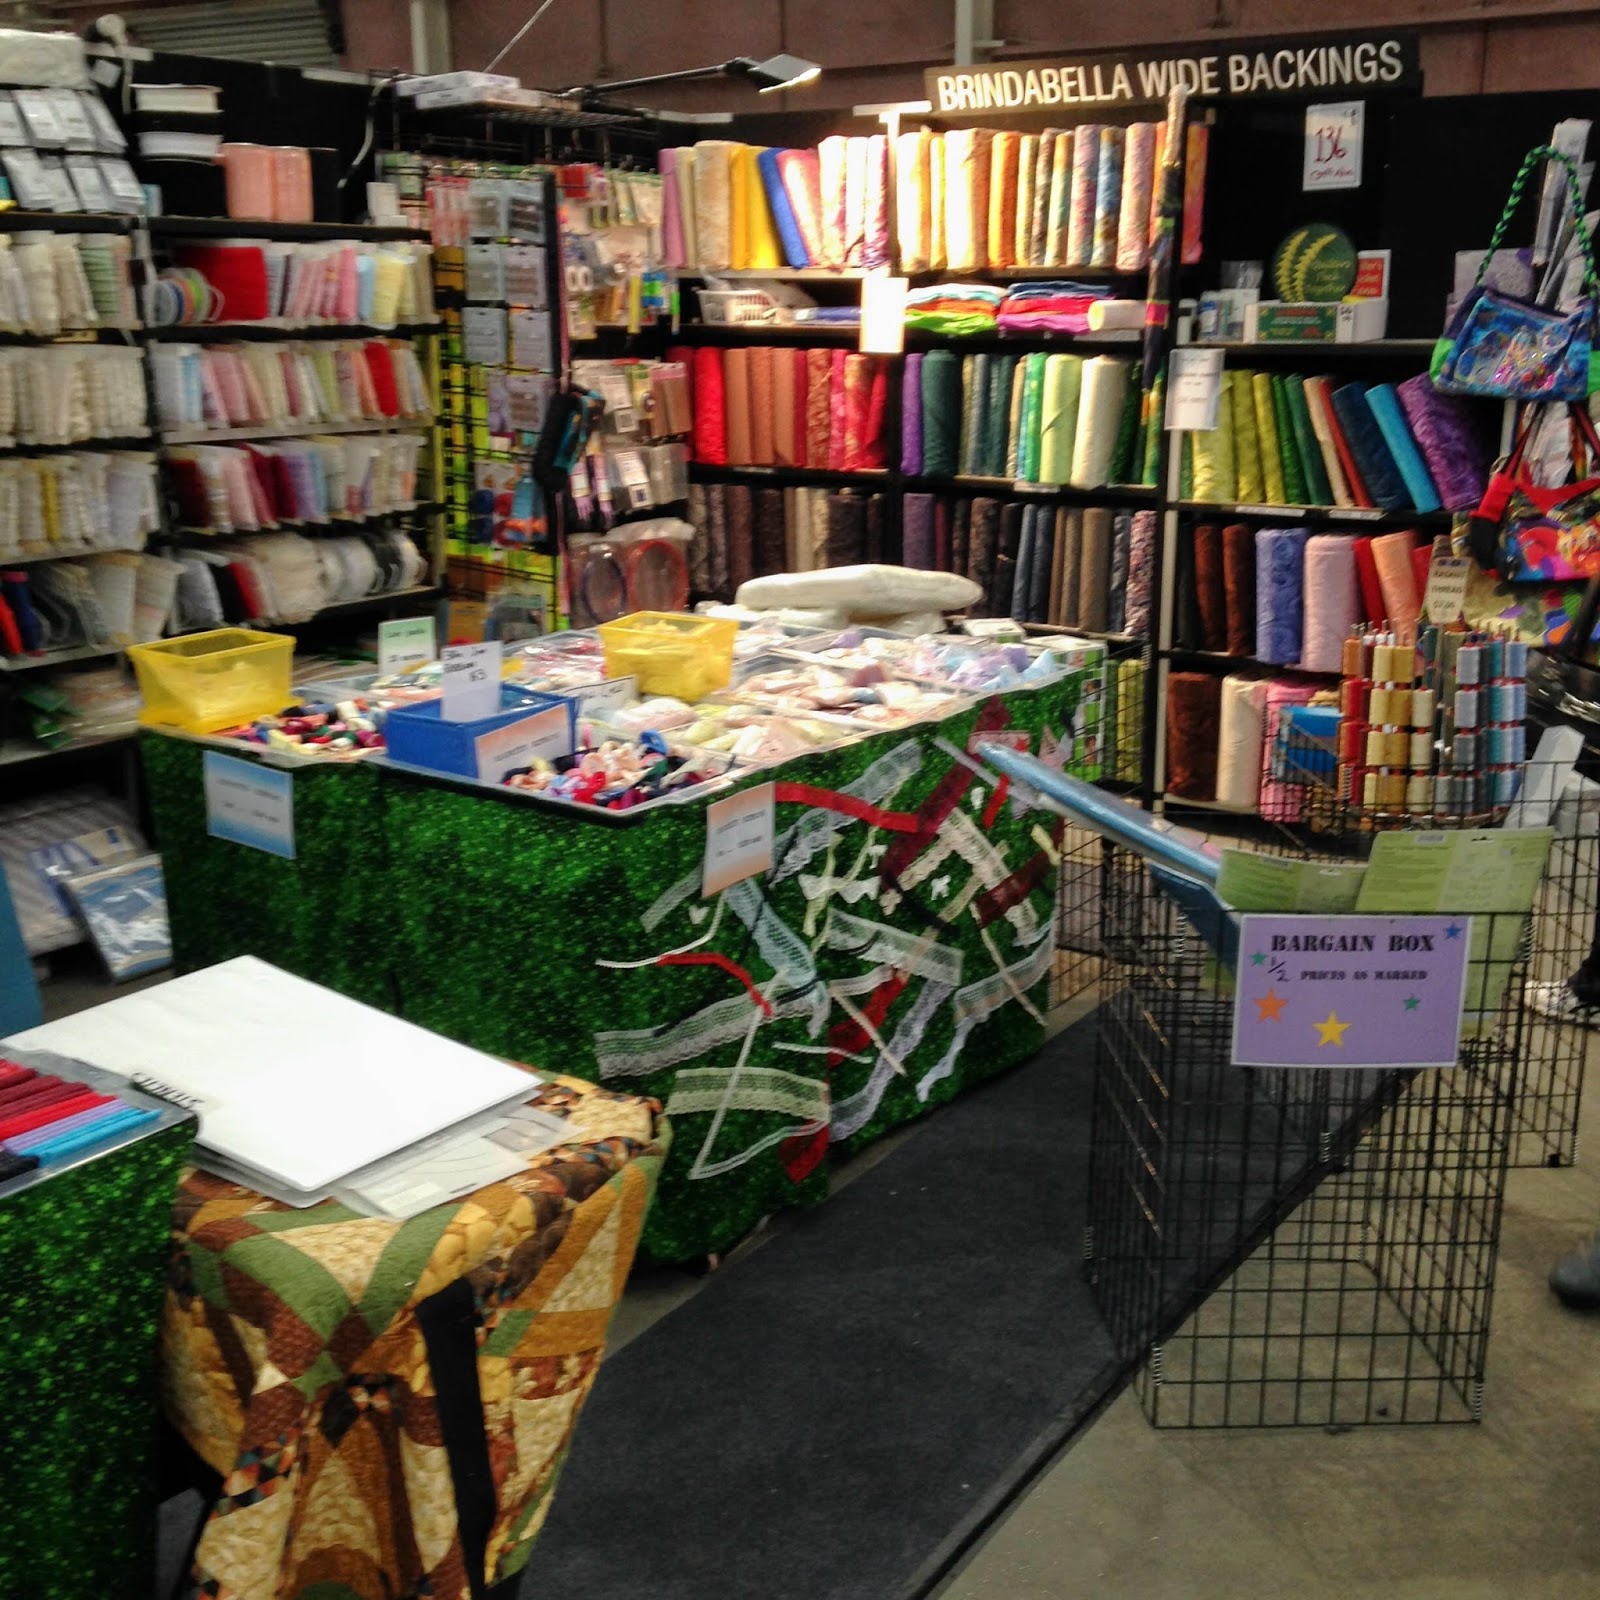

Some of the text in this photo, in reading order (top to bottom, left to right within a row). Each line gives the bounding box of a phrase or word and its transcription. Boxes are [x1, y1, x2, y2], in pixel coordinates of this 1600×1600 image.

[937, 39, 1404, 113] BRINDABELLA WIDE BACKINGS
[1270, 934, 1435, 952] BARGAIN BOX
[1299, 970, 1347, 981] PRICES
[1352, 970, 1368, 981] AS
[1373, 970, 1428, 981] MARKED
